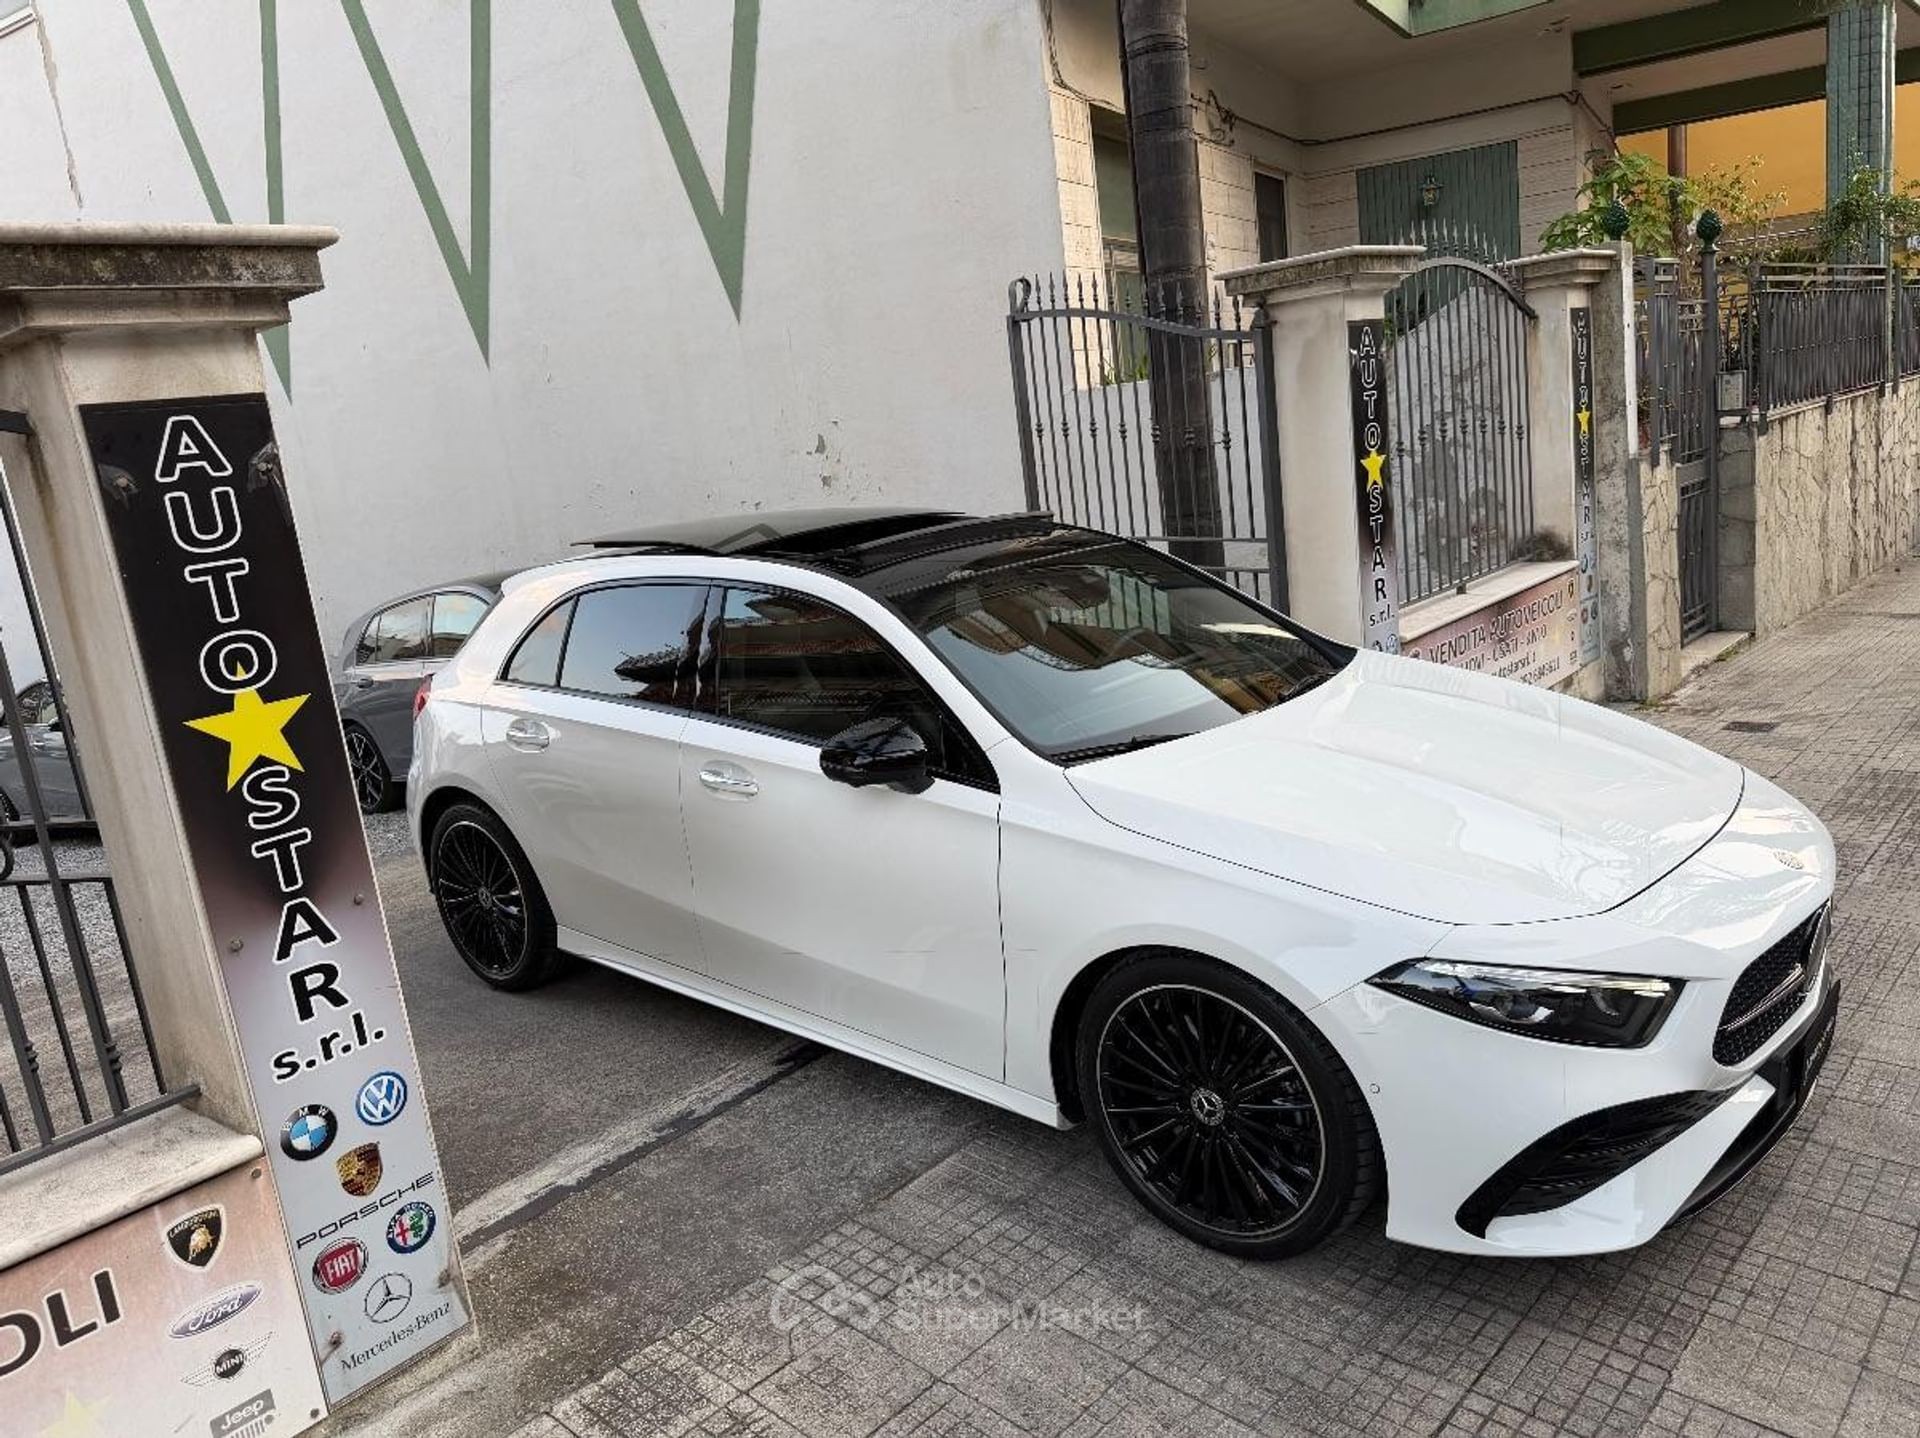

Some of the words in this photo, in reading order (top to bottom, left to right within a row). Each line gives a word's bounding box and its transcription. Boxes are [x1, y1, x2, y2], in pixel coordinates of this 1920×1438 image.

[1360, 326, 1381, 451] AUTO
[1369, 484, 1387, 603] STAR
[1429, 624, 1486, 664] VENDITA
[155, 414, 278, 695] AUTO
[242, 765, 350, 1023] STAR
[272, 1011, 385, 1083] s.r.l.
[296, 1171, 435, 1249] PORSCHE
[324, 1247, 357, 1284] FIAT
[188, 1291, 244, 1331] Ford
[341, 1302, 451, 1371] Mercedes-Benz
[215, 1352, 243, 1374] MINI
[221, 1399, 264, 1430] Jeep
